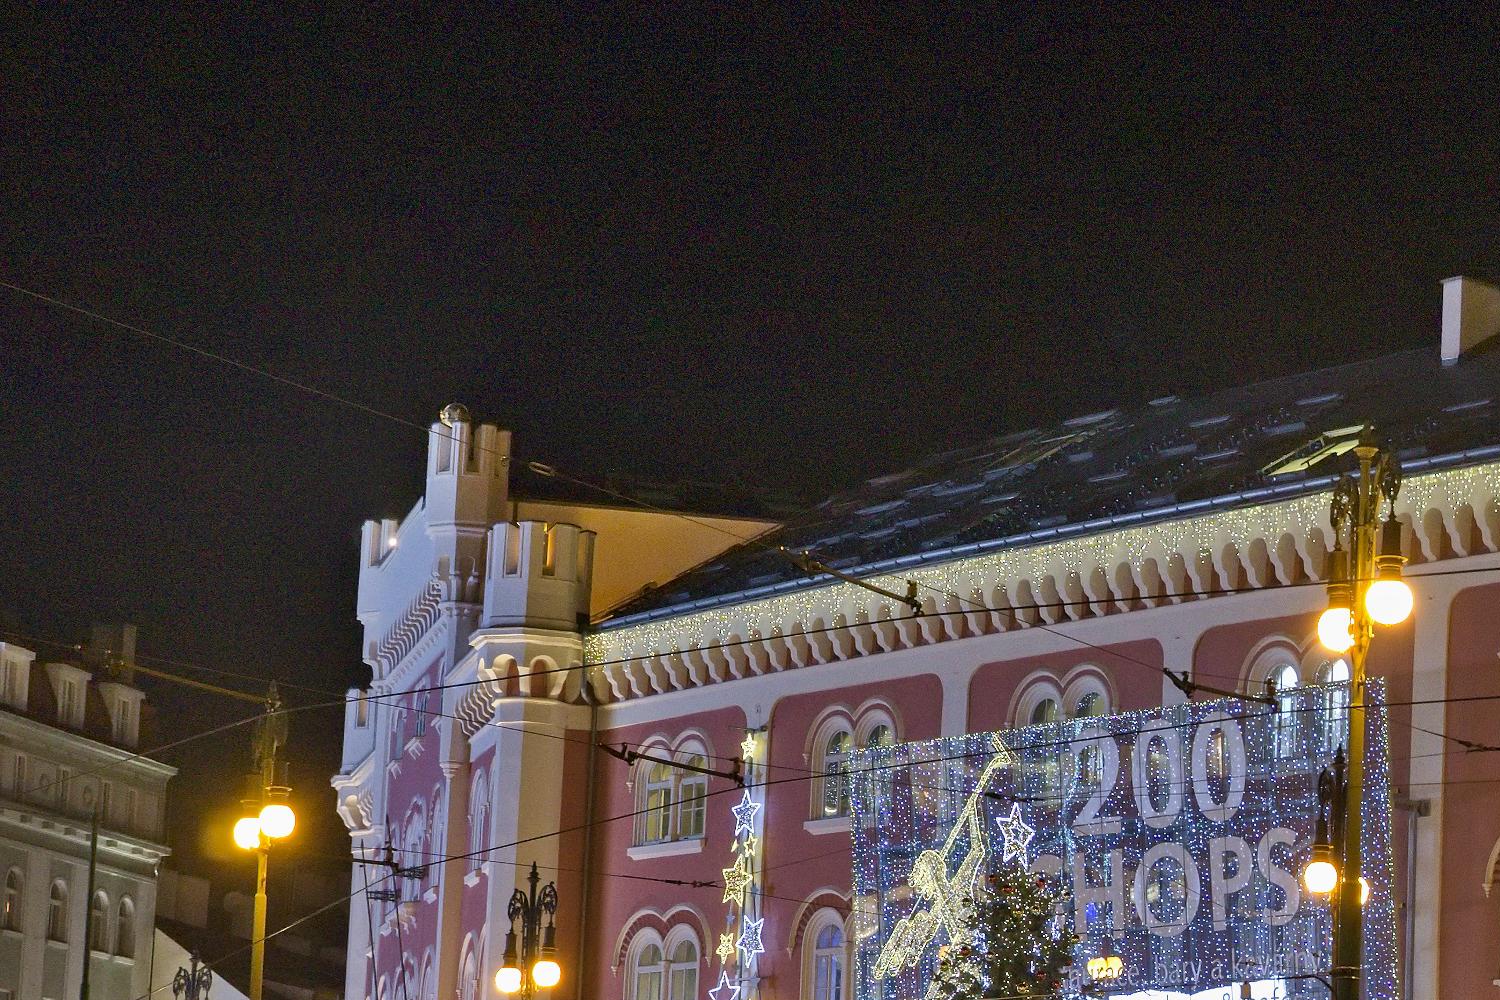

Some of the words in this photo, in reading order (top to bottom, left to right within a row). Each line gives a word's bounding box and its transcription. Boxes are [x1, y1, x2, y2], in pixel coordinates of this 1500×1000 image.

[1070, 711, 1246, 836] 200
[1155, 953, 1202, 990] bary
[1211, 958, 1224, 980] a
